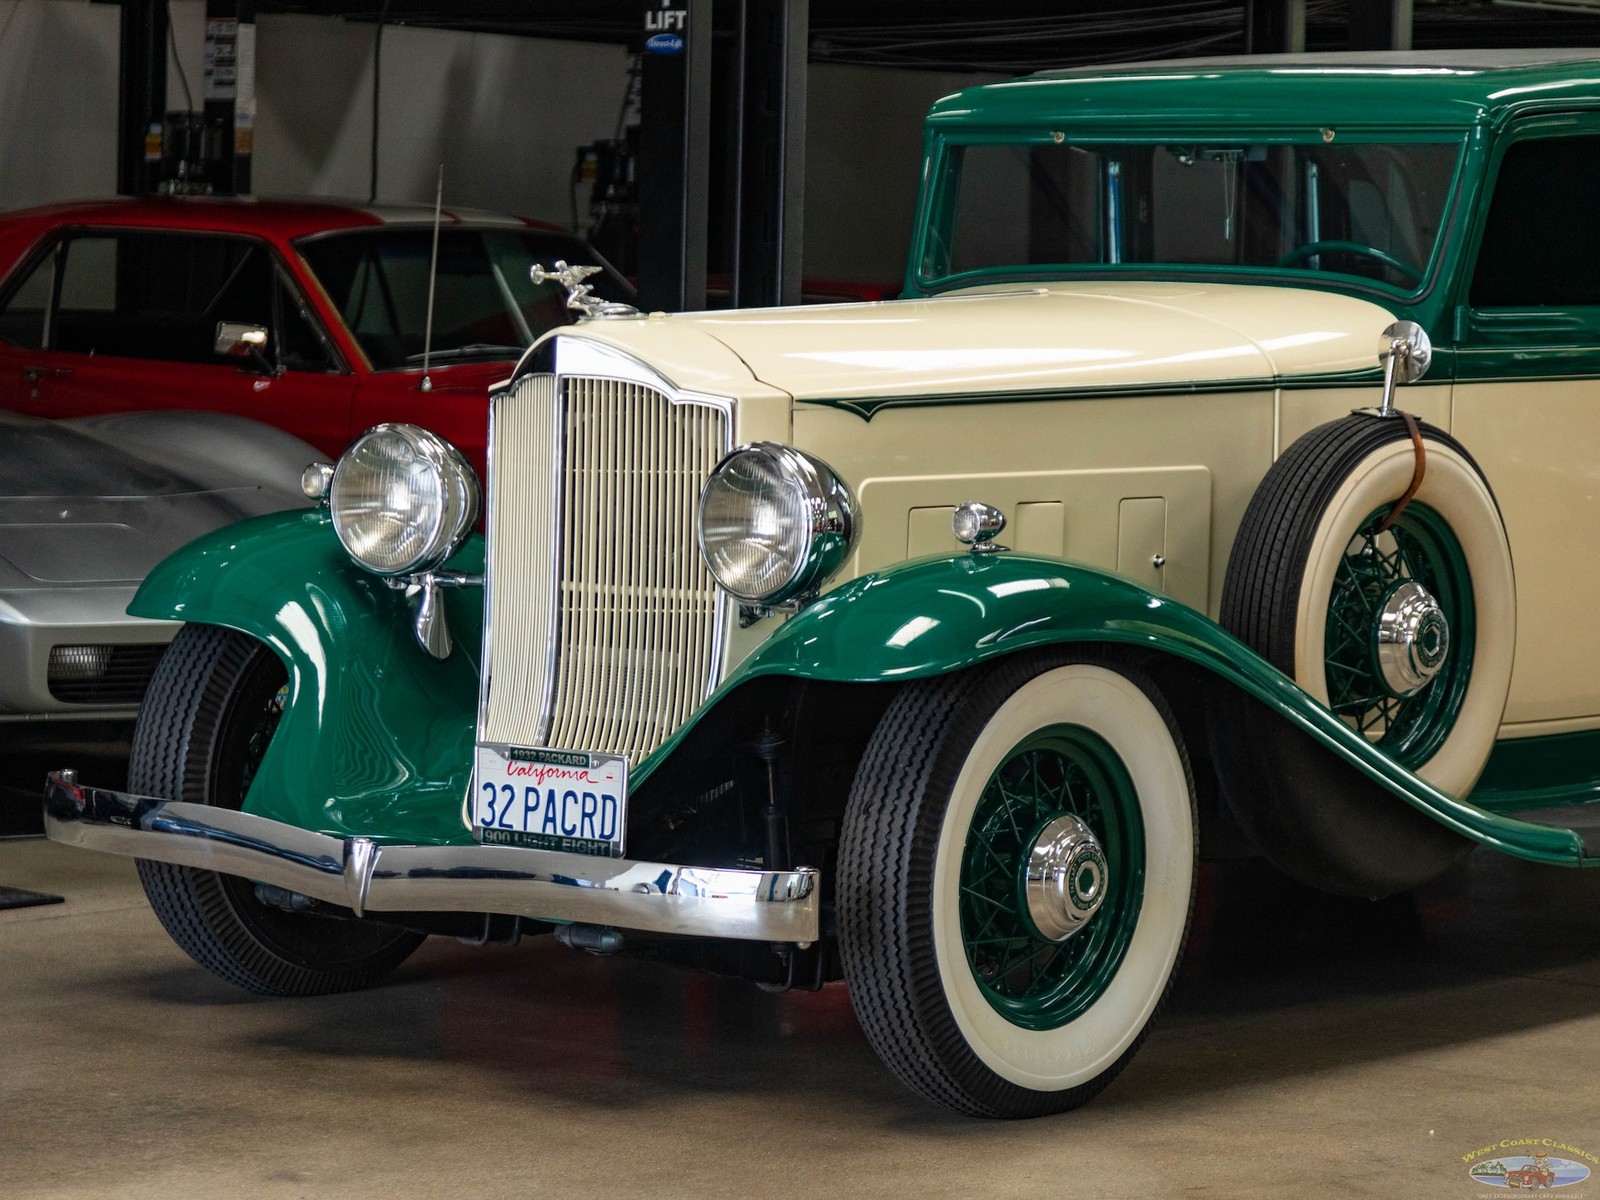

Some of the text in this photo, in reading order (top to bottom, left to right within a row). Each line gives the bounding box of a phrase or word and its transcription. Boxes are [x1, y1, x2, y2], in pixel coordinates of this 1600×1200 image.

[646, 10, 687, 30] LIFT
[513, 749, 537, 761] 1932
[539, 752, 587, 766] PACKARD
[507, 761, 599, 786] California
[480, 781, 618, 841] 32 PACRD
[485, 830, 511, 844] 900
[562, 839, 609, 856] EIGHT
